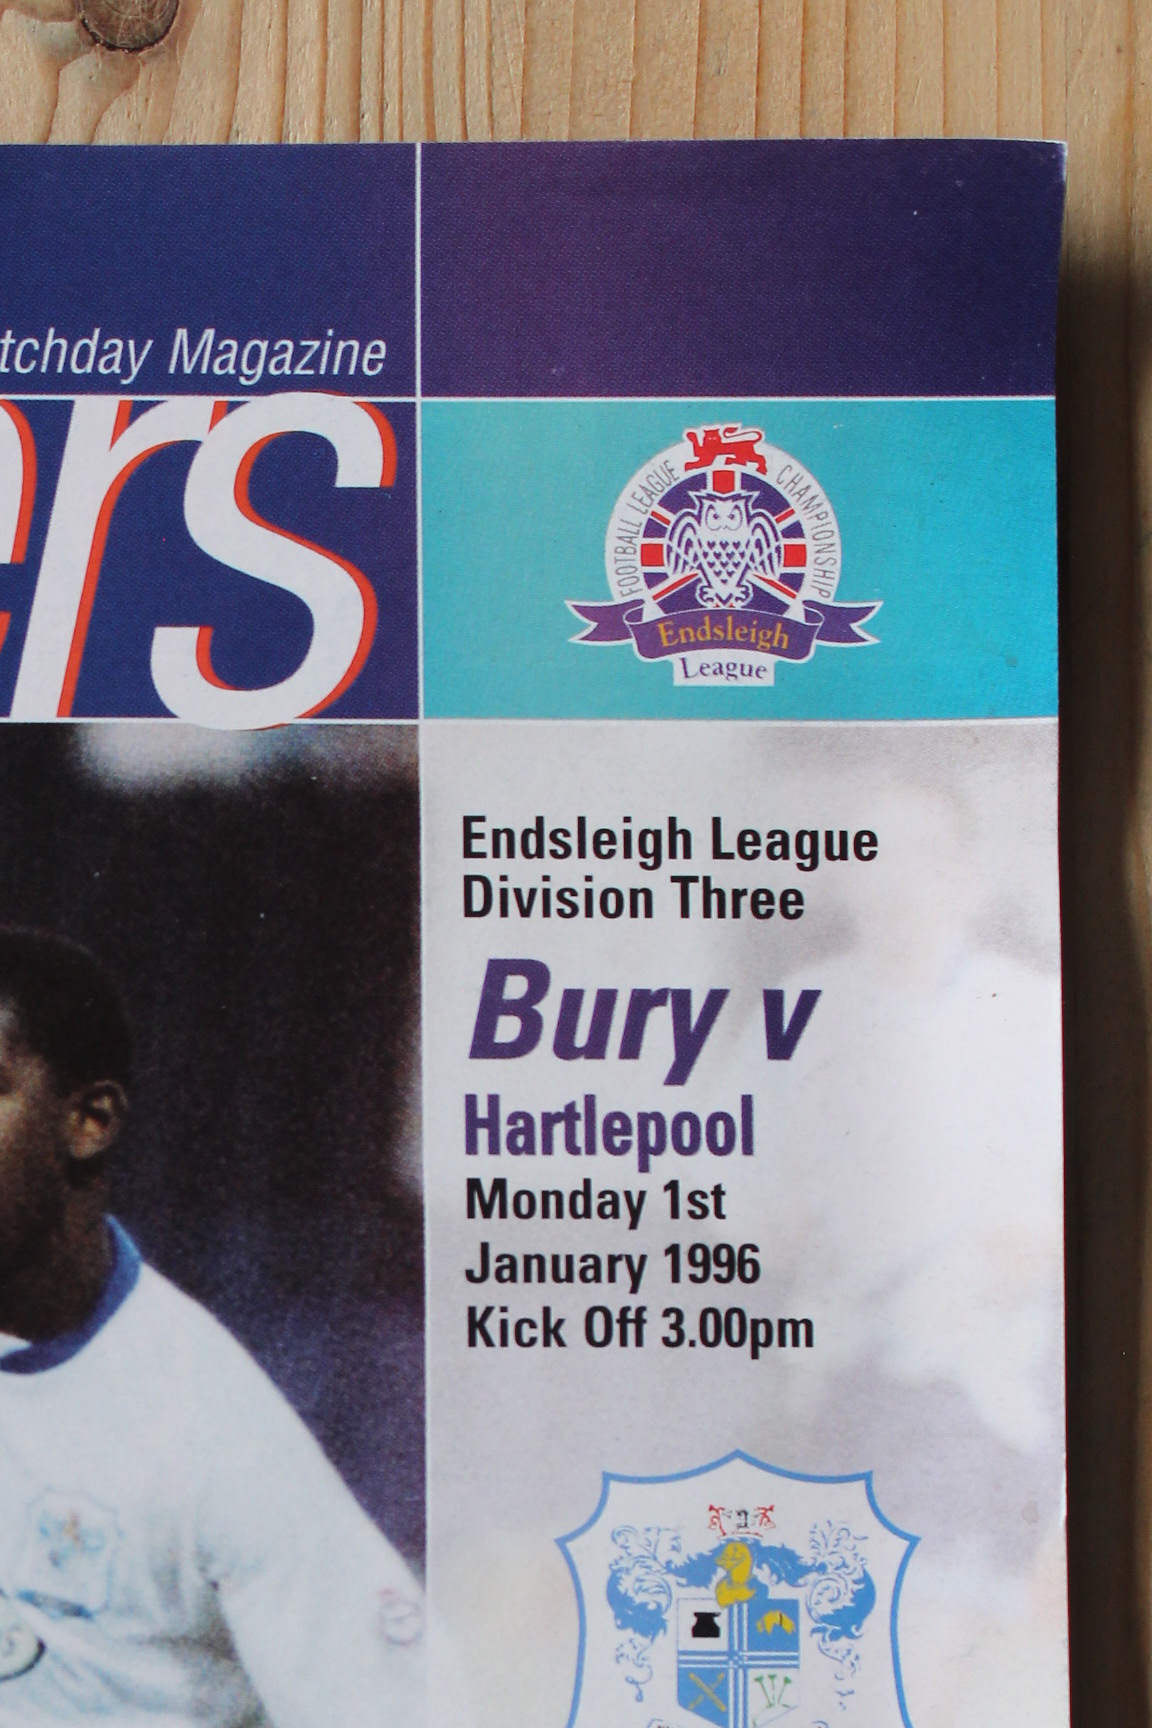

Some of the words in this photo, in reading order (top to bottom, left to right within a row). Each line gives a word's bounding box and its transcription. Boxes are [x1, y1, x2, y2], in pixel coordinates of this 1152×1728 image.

[167, 327, 388, 386] Magazine
[626, 459, 680, 515] LEAGUE
[613, 518, 643, 598] FOOTBALL
[776, 464, 838, 599] CHAMPIONSHIP
[657, 614, 790, 651] Endsleigh
[679, 657, 768, 682] League
[461, 815, 692, 871] Endsleigh
[711, 816, 879, 872] League
[462, 875, 654, 919] Division
[670, 875, 805, 920] Three
[468, 957, 730, 1086] Bury
[762, 989, 822, 1061] v
[464, 1094, 755, 1173] Hartlepool
[465, 1177, 647, 1230] Monday
[663, 1180, 726, 1220] 1st
[465, 1242, 648, 1294] January
[664, 1243, 761, 1284] 1996
[466, 1306, 567, 1348] Kick
[583, 1306, 648, 1348] Off
[661, 1307, 815, 1360] 3.00pm
